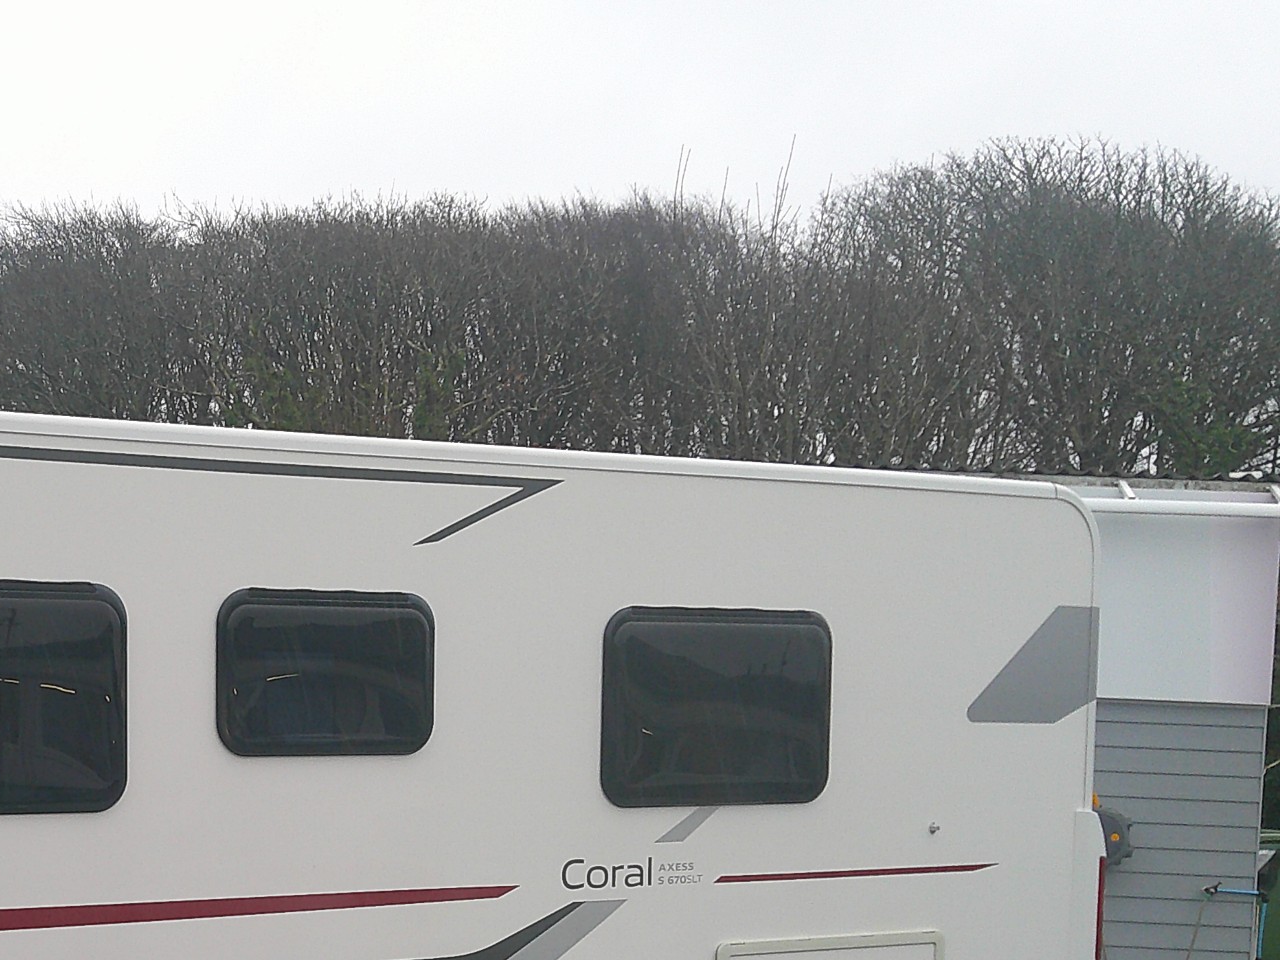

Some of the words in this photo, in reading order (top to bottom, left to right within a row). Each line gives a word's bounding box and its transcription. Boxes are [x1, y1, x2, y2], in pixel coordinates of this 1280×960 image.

[658, 862, 694, 872] AXESS
[561, 857, 652, 889] Coral
[658, 877, 665, 885] S
[667, 874, 703, 885] 670SLT
